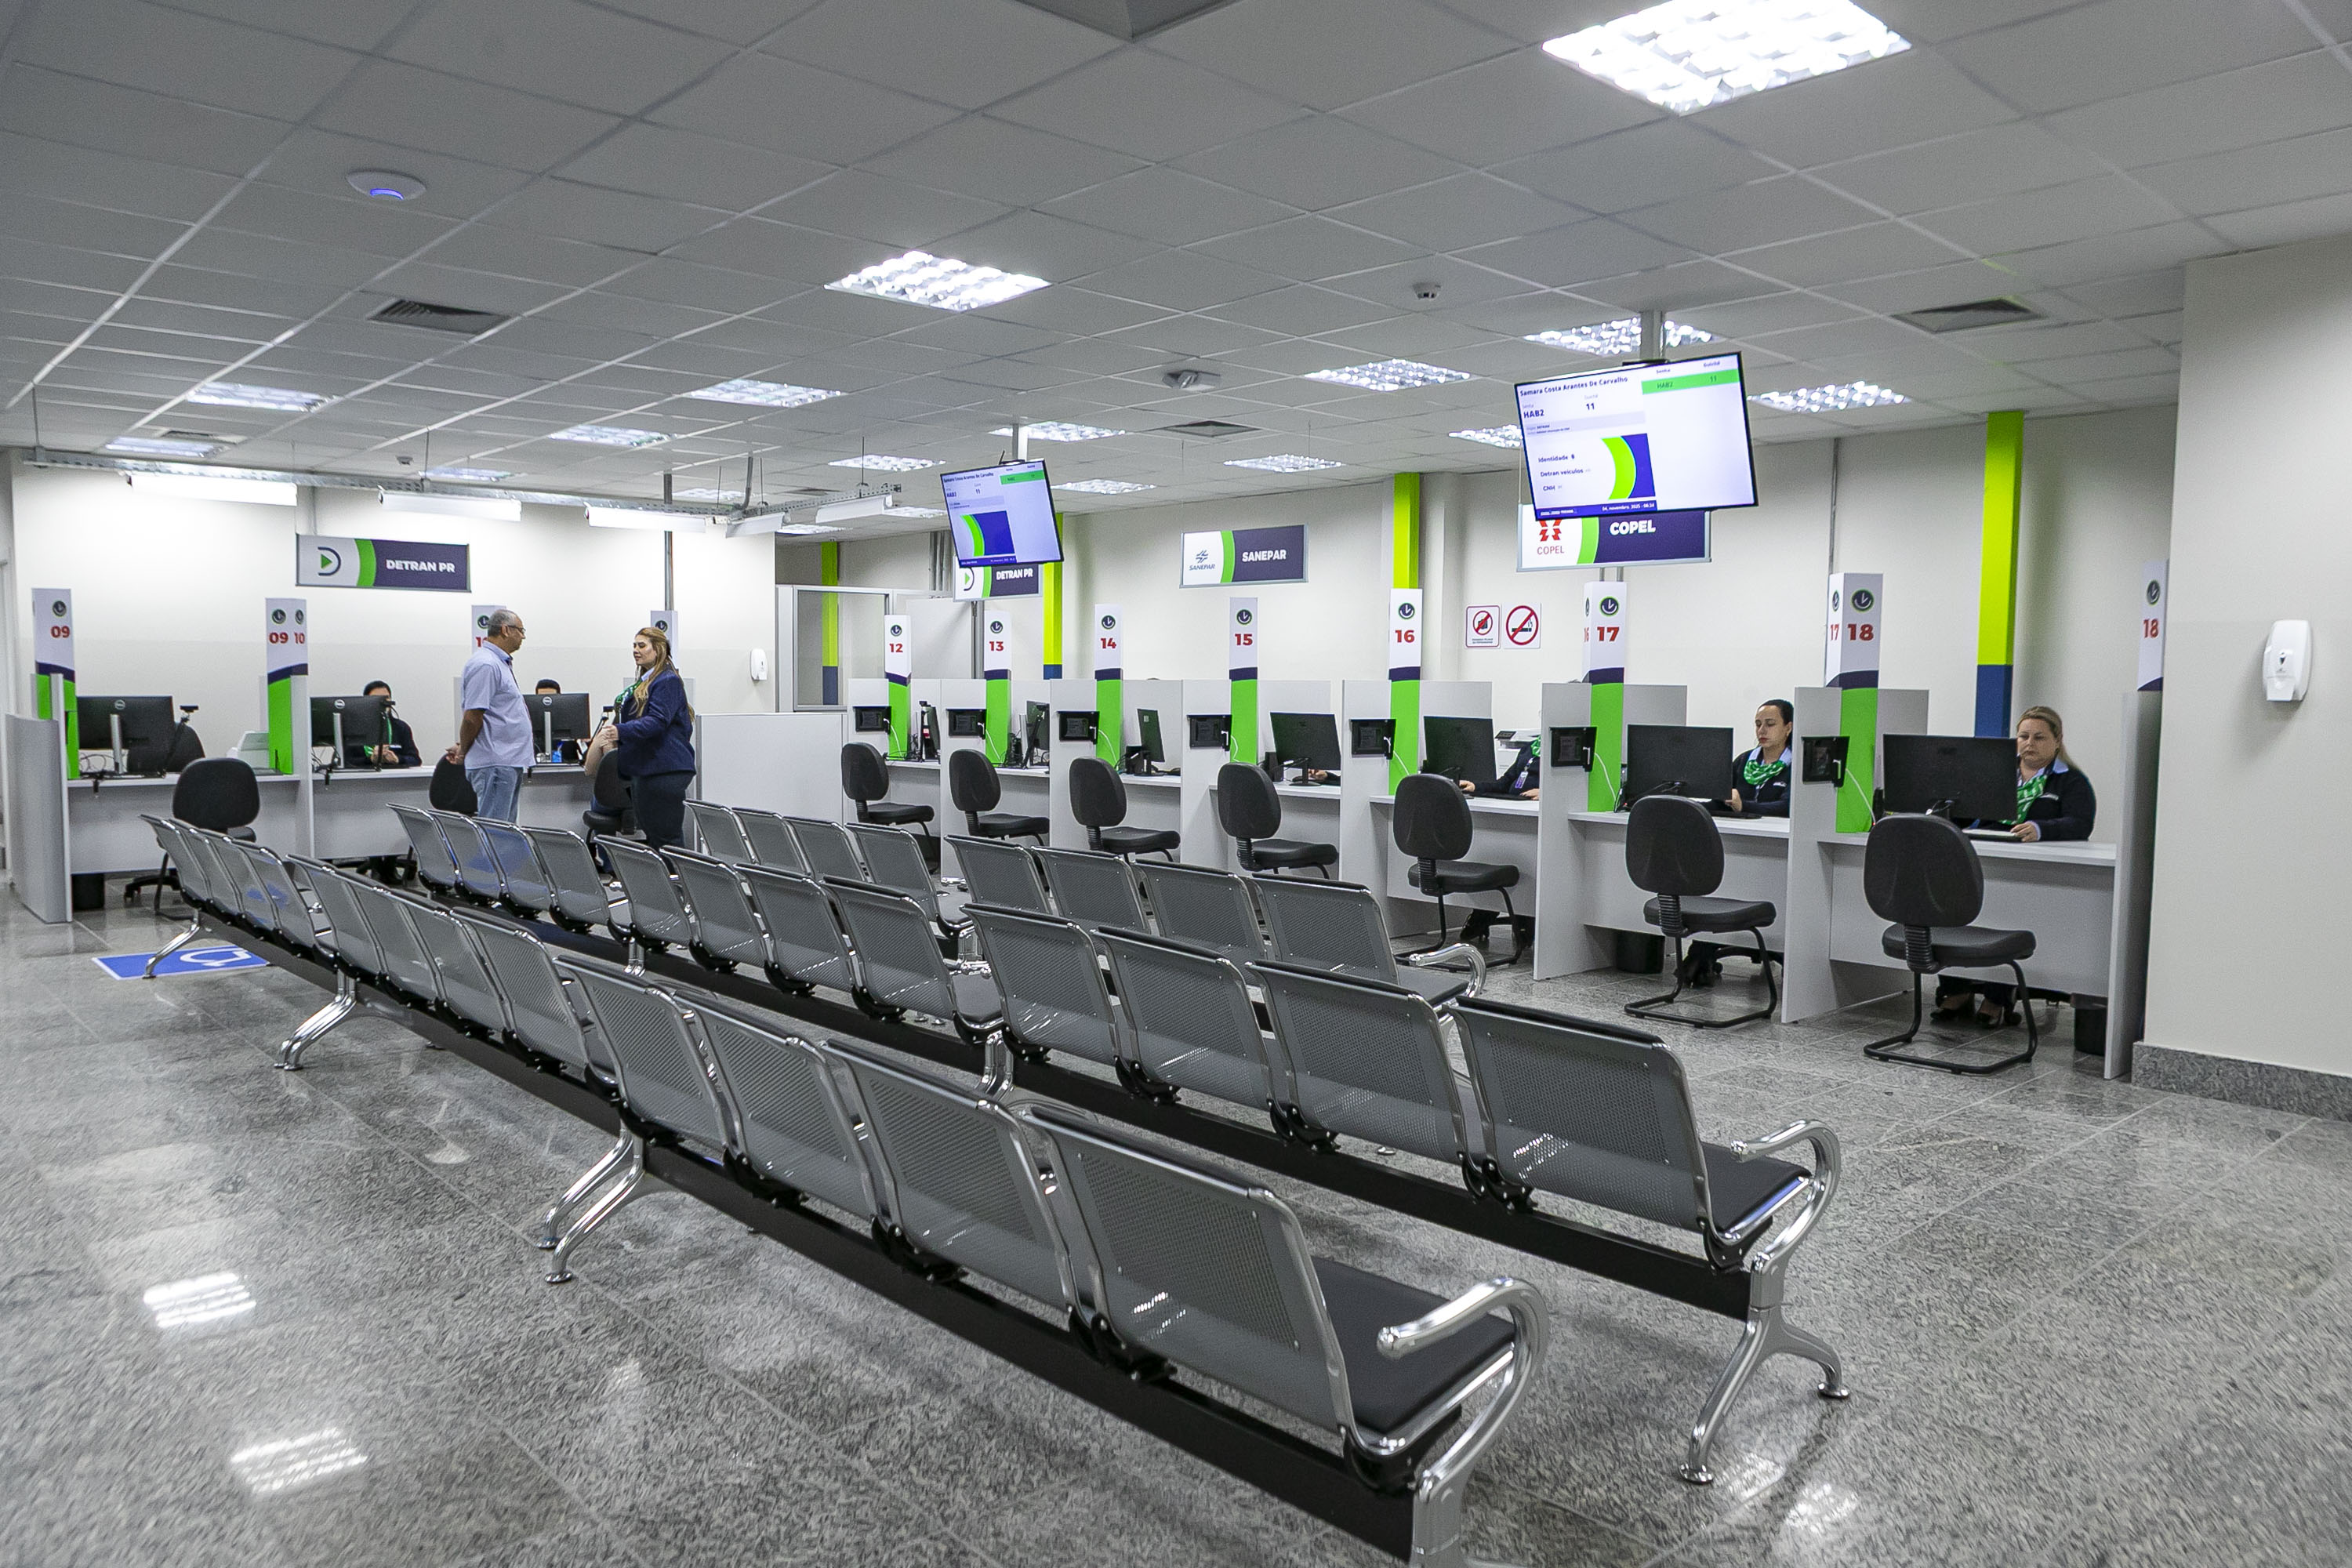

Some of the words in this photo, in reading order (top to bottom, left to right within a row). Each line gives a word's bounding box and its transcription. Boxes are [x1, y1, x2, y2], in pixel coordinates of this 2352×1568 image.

[1544, 384, 1562, 393] Costa
[1563, 381, 1588, 390] Arantes
[1599, 376, 1628, 385] Carvalho
[1523, 408, 1545, 419] HAB2
[1610, 519, 1657, 535] COPEL
[1242, 550, 1287, 562] SANEPAR
[1537, 546, 1565, 555] COPEL
[385, 559, 437, 573] DETRAN
[438, 563, 456, 573] PR
[996, 569, 1023, 580] DETRAN
[1023, 568, 1033, 578] PR
[50, 626, 71, 638] 09
[1597, 626, 1620, 641] 17
[1831, 623, 1839, 641] 17
[1847, 623, 1874, 641] 18
[2143, 619, 2158, 638] 18
[269, 632, 289, 644] 09
[294, 632, 305, 644] 10
[475, 637, 488, 648] 1
[1235, 633, 1253, 646] 15
[1395, 630, 1415, 643] 16
[889, 642, 903, 653] 12
[989, 641, 1004, 652] 13
[1100, 637, 1117, 649] 14
